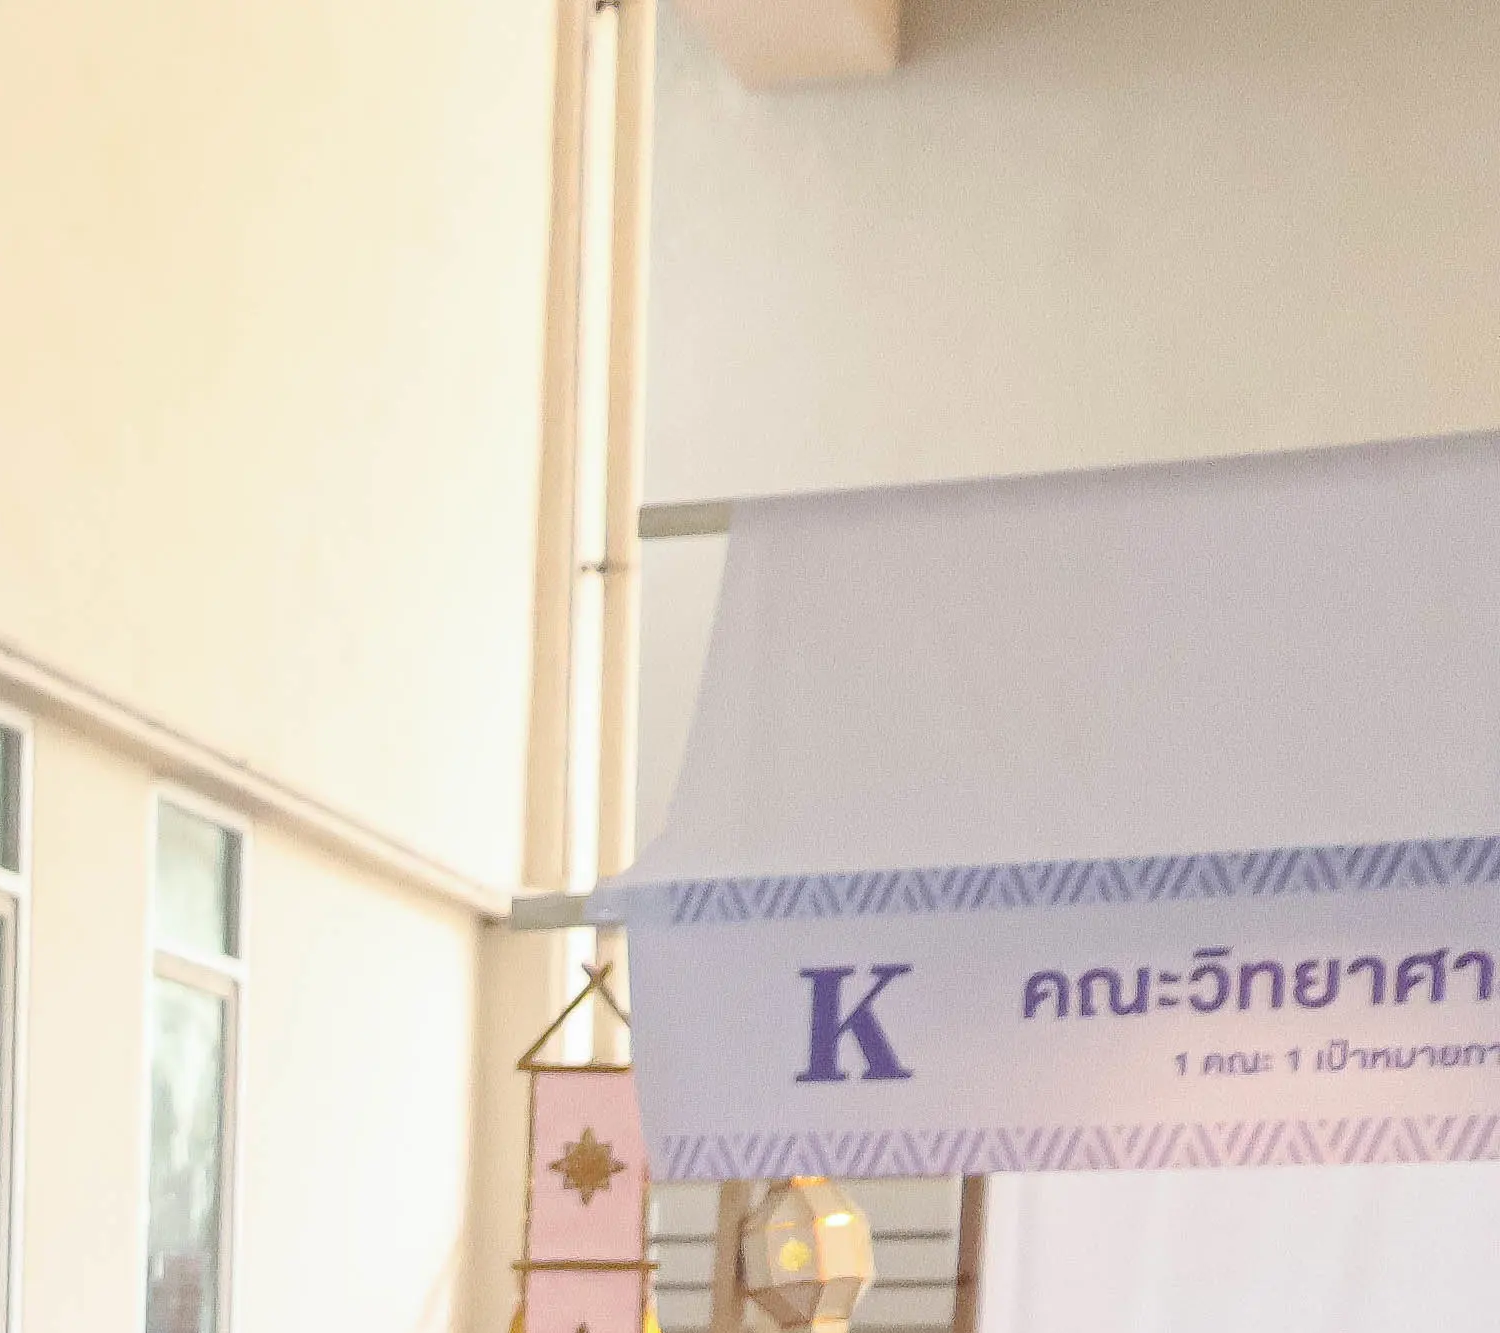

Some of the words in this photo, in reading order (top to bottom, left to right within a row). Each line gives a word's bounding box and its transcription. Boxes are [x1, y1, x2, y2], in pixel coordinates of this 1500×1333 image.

[1022, 945, 1500, 1020] คณะวิทยาศา
[793, 962, 913, 1083] K
[1174, 1050, 1186, 1076] 1
[1202, 1049, 1272, 1076] คณะ
[1288, 1048, 1300, 1074] 1
